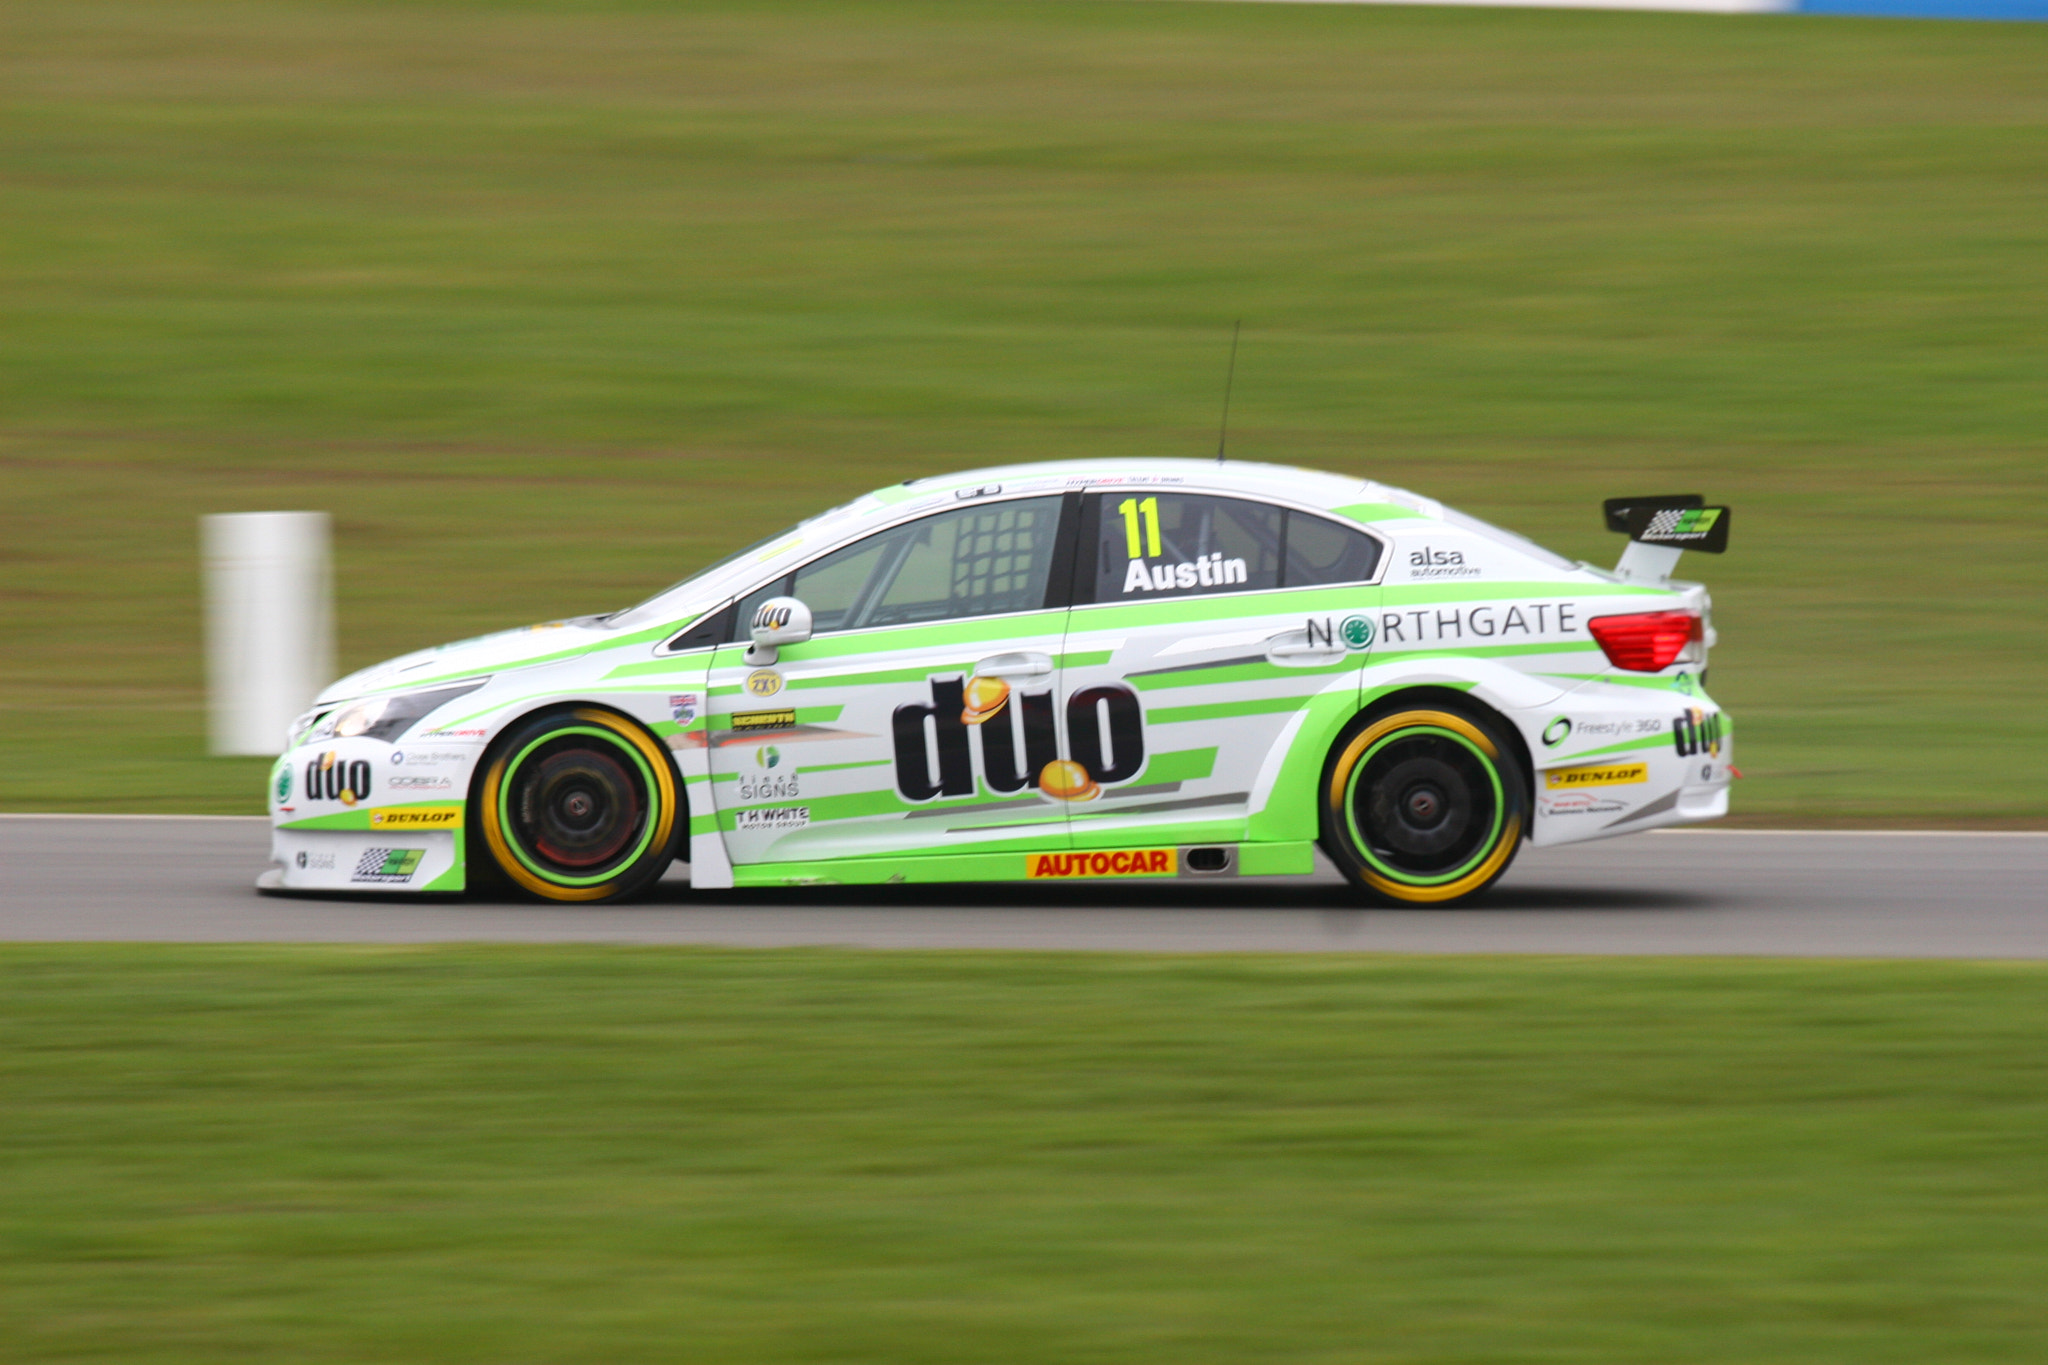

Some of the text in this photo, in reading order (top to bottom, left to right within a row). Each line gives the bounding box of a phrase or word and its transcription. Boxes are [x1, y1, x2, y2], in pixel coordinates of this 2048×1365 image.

[1119, 497, 1162, 559] 11
[1410, 546, 1465, 566] alsa
[1122, 552, 1248, 594] Austin
[1410, 566, 1482, 577] automotive
[1577, 719, 1662, 736] Freestyle 360
[892, 674, 1145, 801] duo
[306, 752, 371, 801] duo
[389, 777, 452, 786] COBRA
[1565, 769, 1642, 783] DUNLOP
[740, 781, 800, 800] SIGNS
[386, 812, 456, 823] DUNLOP
[761, 807, 809, 821] WHITE
[1034, 850, 1168, 877] AUTOCAR
